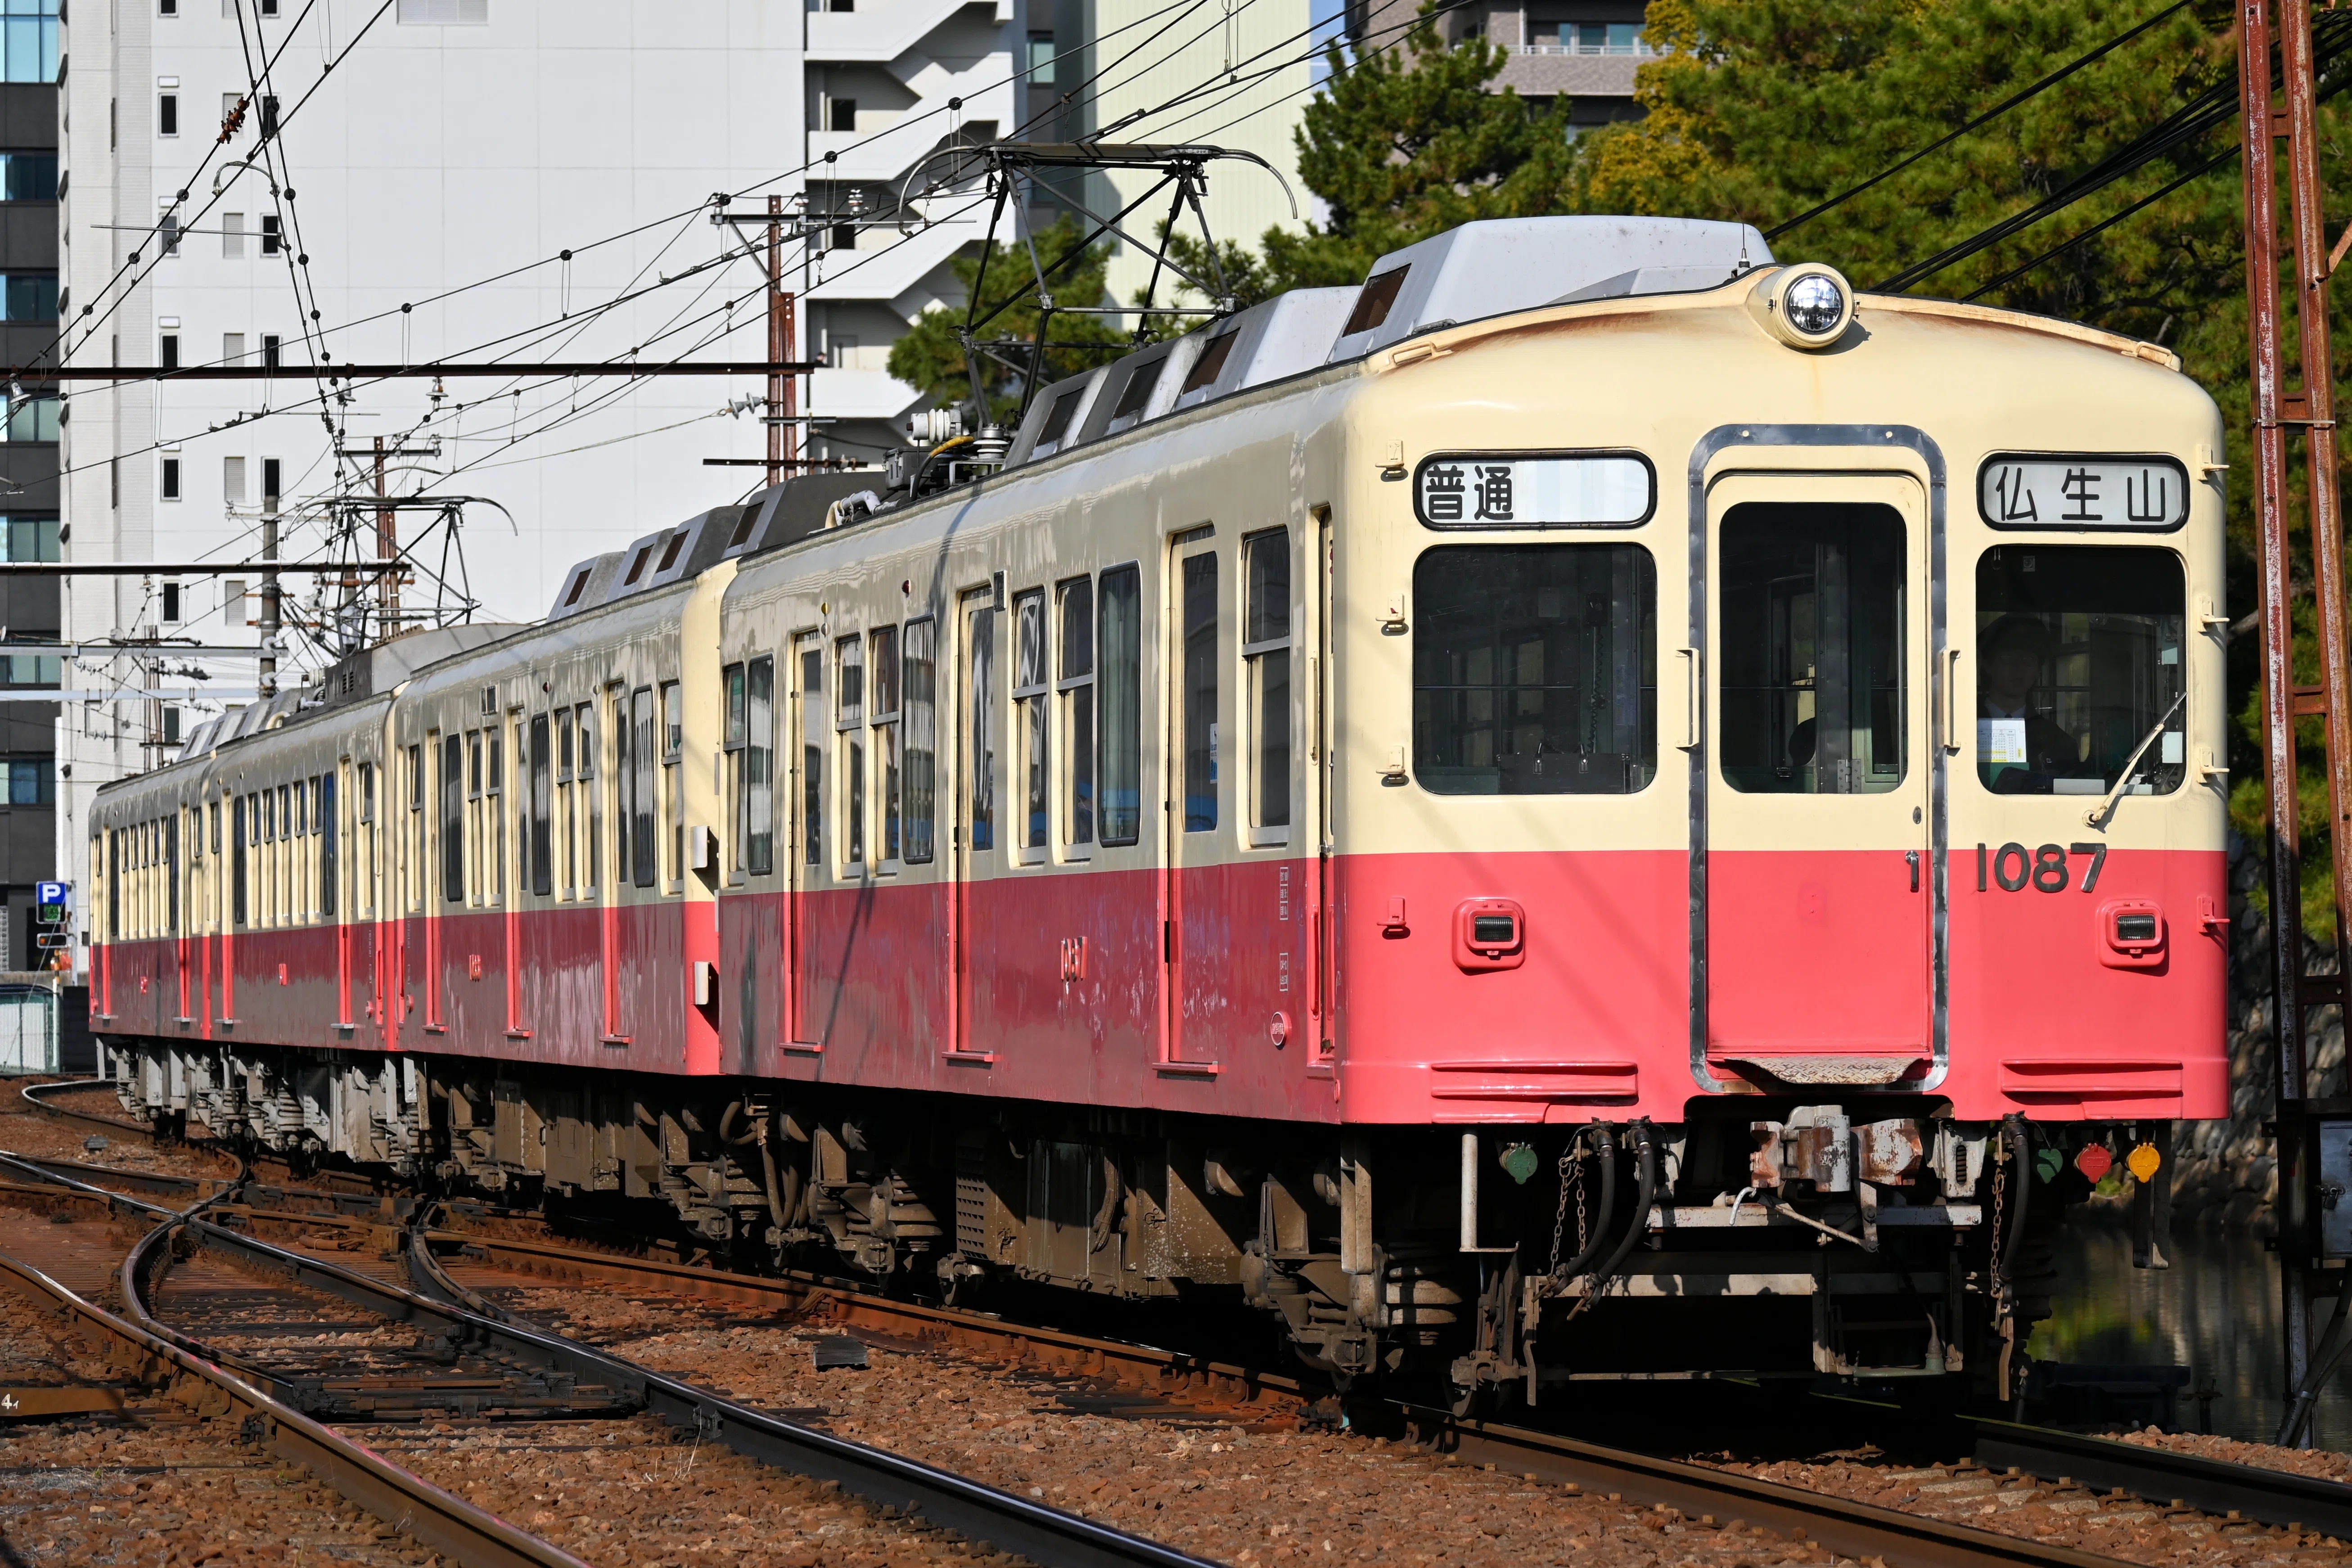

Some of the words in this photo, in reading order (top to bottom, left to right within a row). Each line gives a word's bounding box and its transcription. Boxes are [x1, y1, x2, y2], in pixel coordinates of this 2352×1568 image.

[1425, 465, 1514, 520] 普通
[1996, 466, 2165, 522] 仏生山
[42, 884, 61, 903] P
[1976, 842, 2107, 894] 1087
